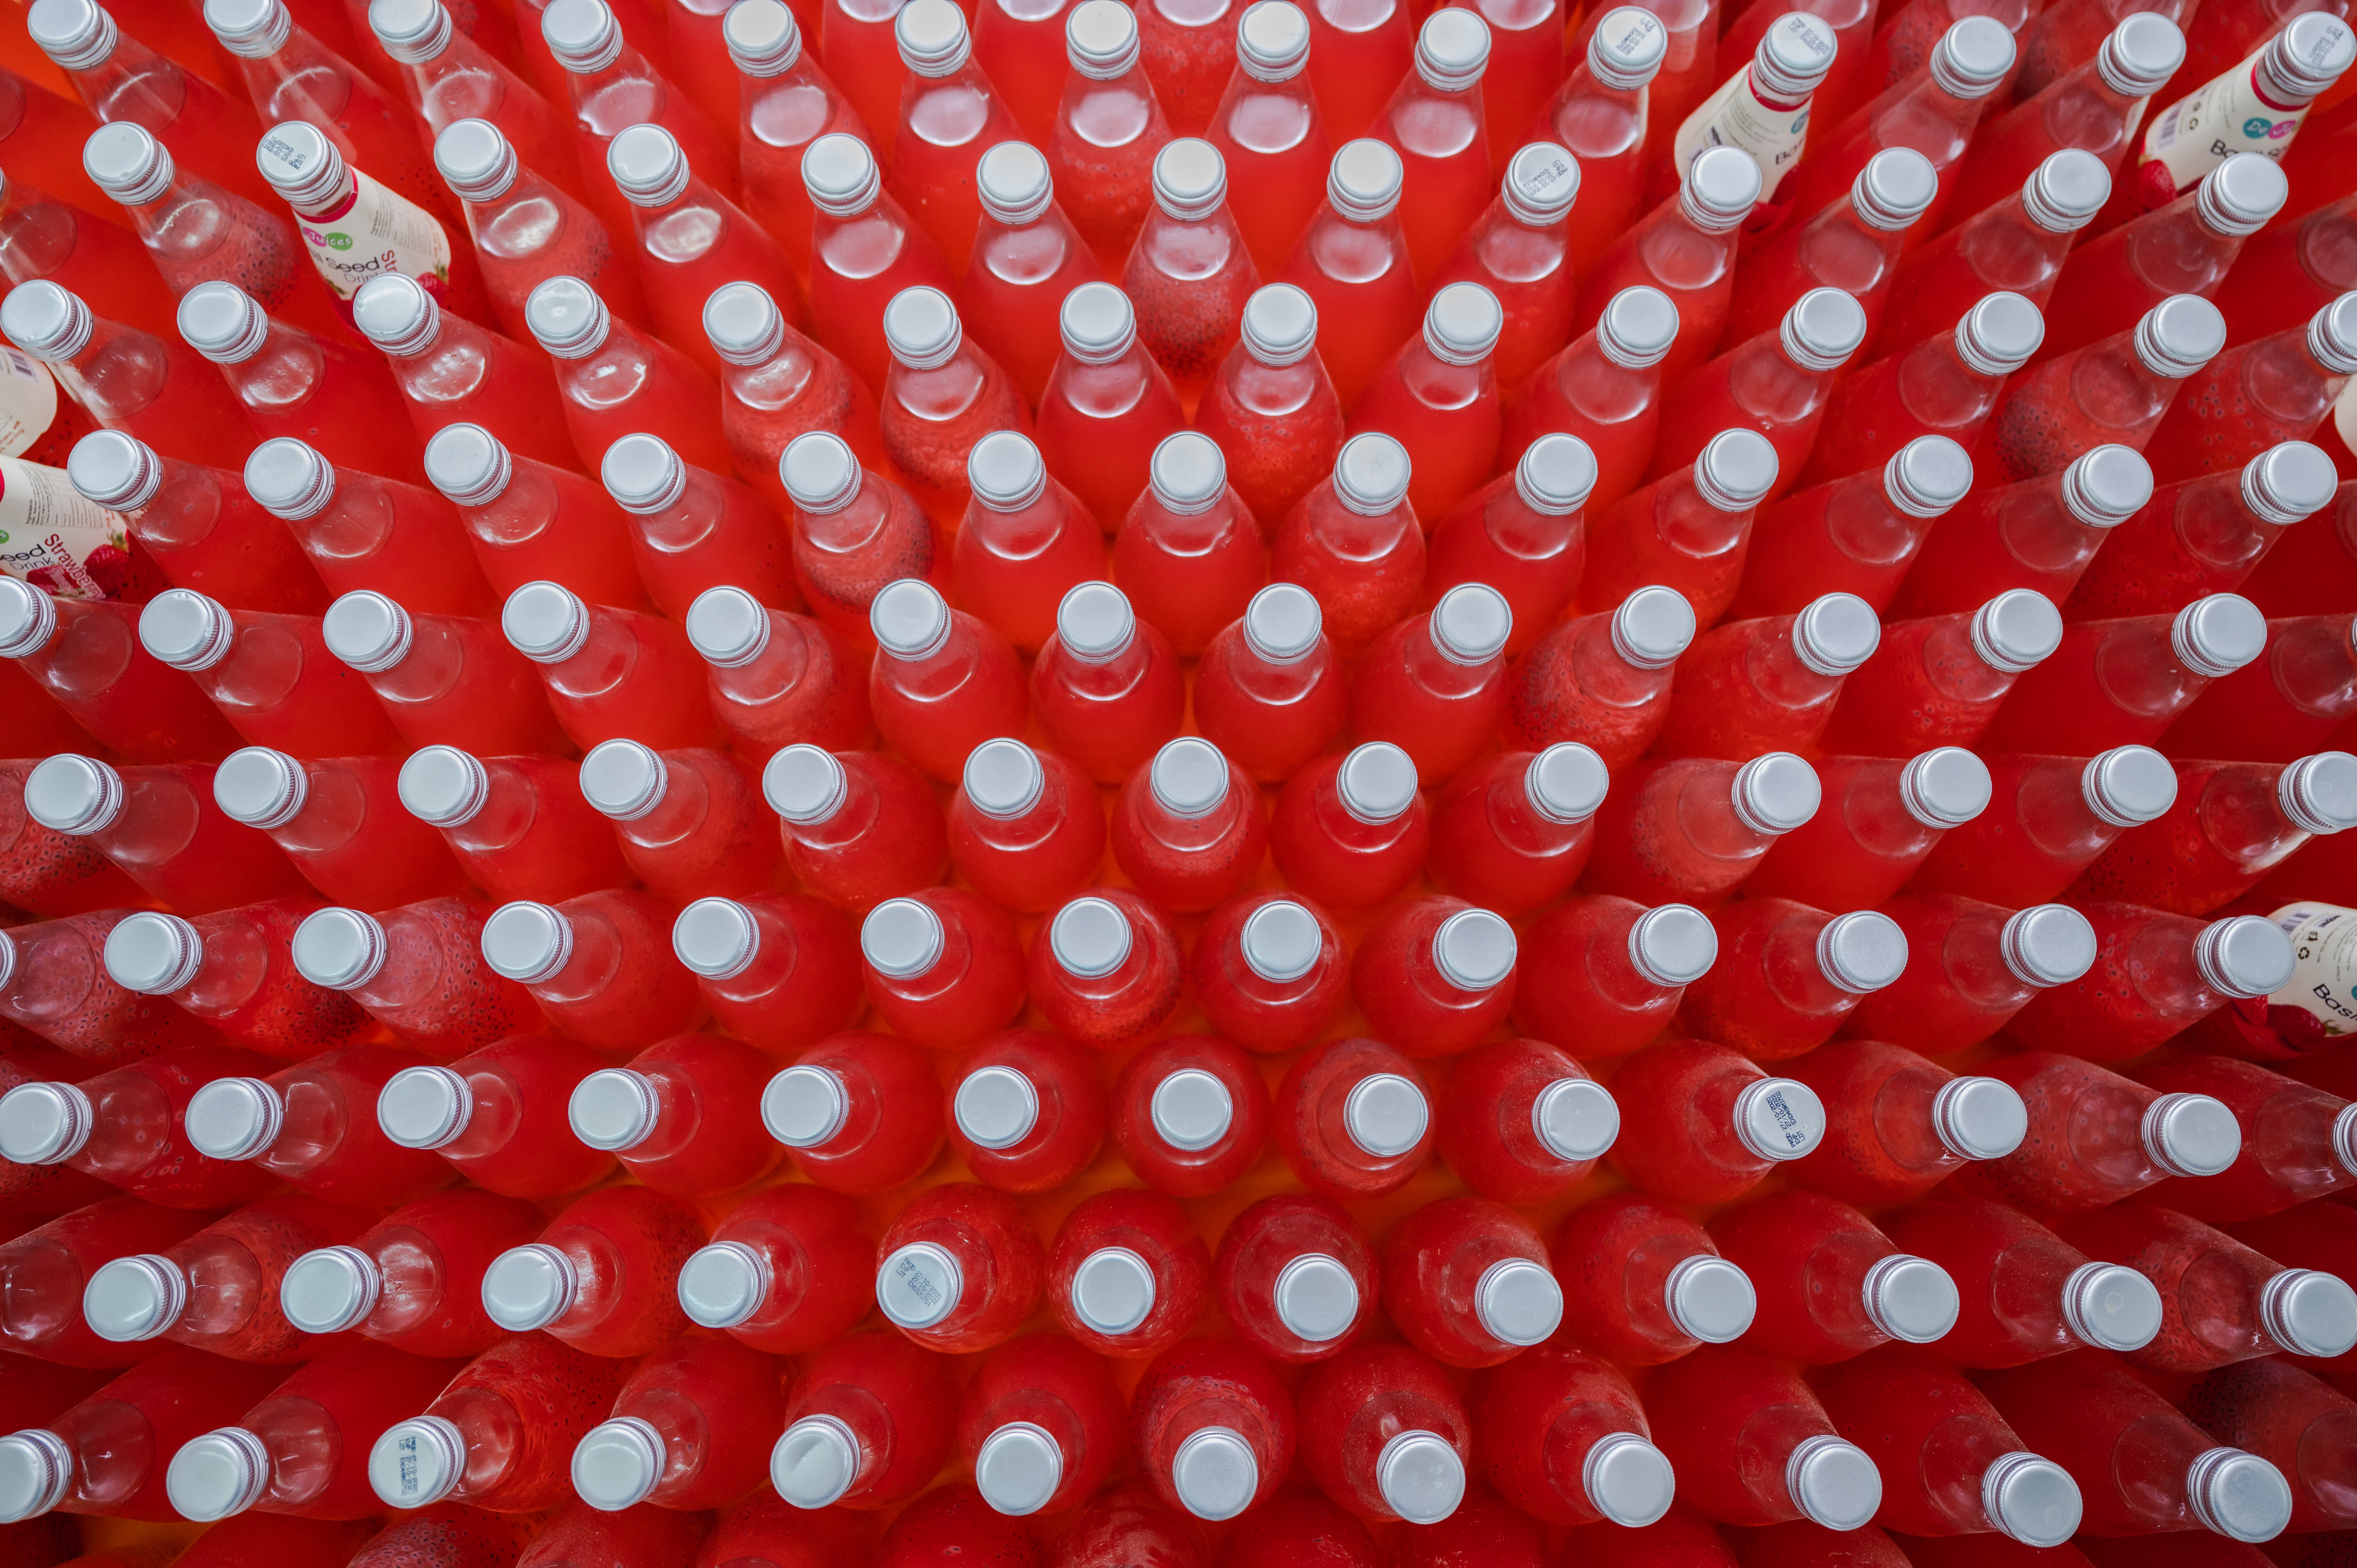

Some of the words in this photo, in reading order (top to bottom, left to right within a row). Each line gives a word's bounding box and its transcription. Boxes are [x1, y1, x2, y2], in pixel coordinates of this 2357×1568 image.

[289, 160, 300, 170] PROD
[1552, 159, 1560, 168] LOT
[1557, 167, 1568, 177] PROD
[308, 231, 351, 245] Juices
[325, 256, 380, 272] Seed
[0, 544, 46, 562] eed
[9, 557, 55, 570] Drink
[45, 533, 106, 599] Strawberry
[2313, 983, 2357, 1020] Basi
[1786, 1133, 1796, 1148] PROD
[1792, 1134, 1800, 1144] EXP
[1796, 1131, 1805, 1140] LOT
[900, 1263, 909, 1271] EXP
[904, 1258, 915, 1271] PROD
[896, 1268, 906, 1278] LOT
